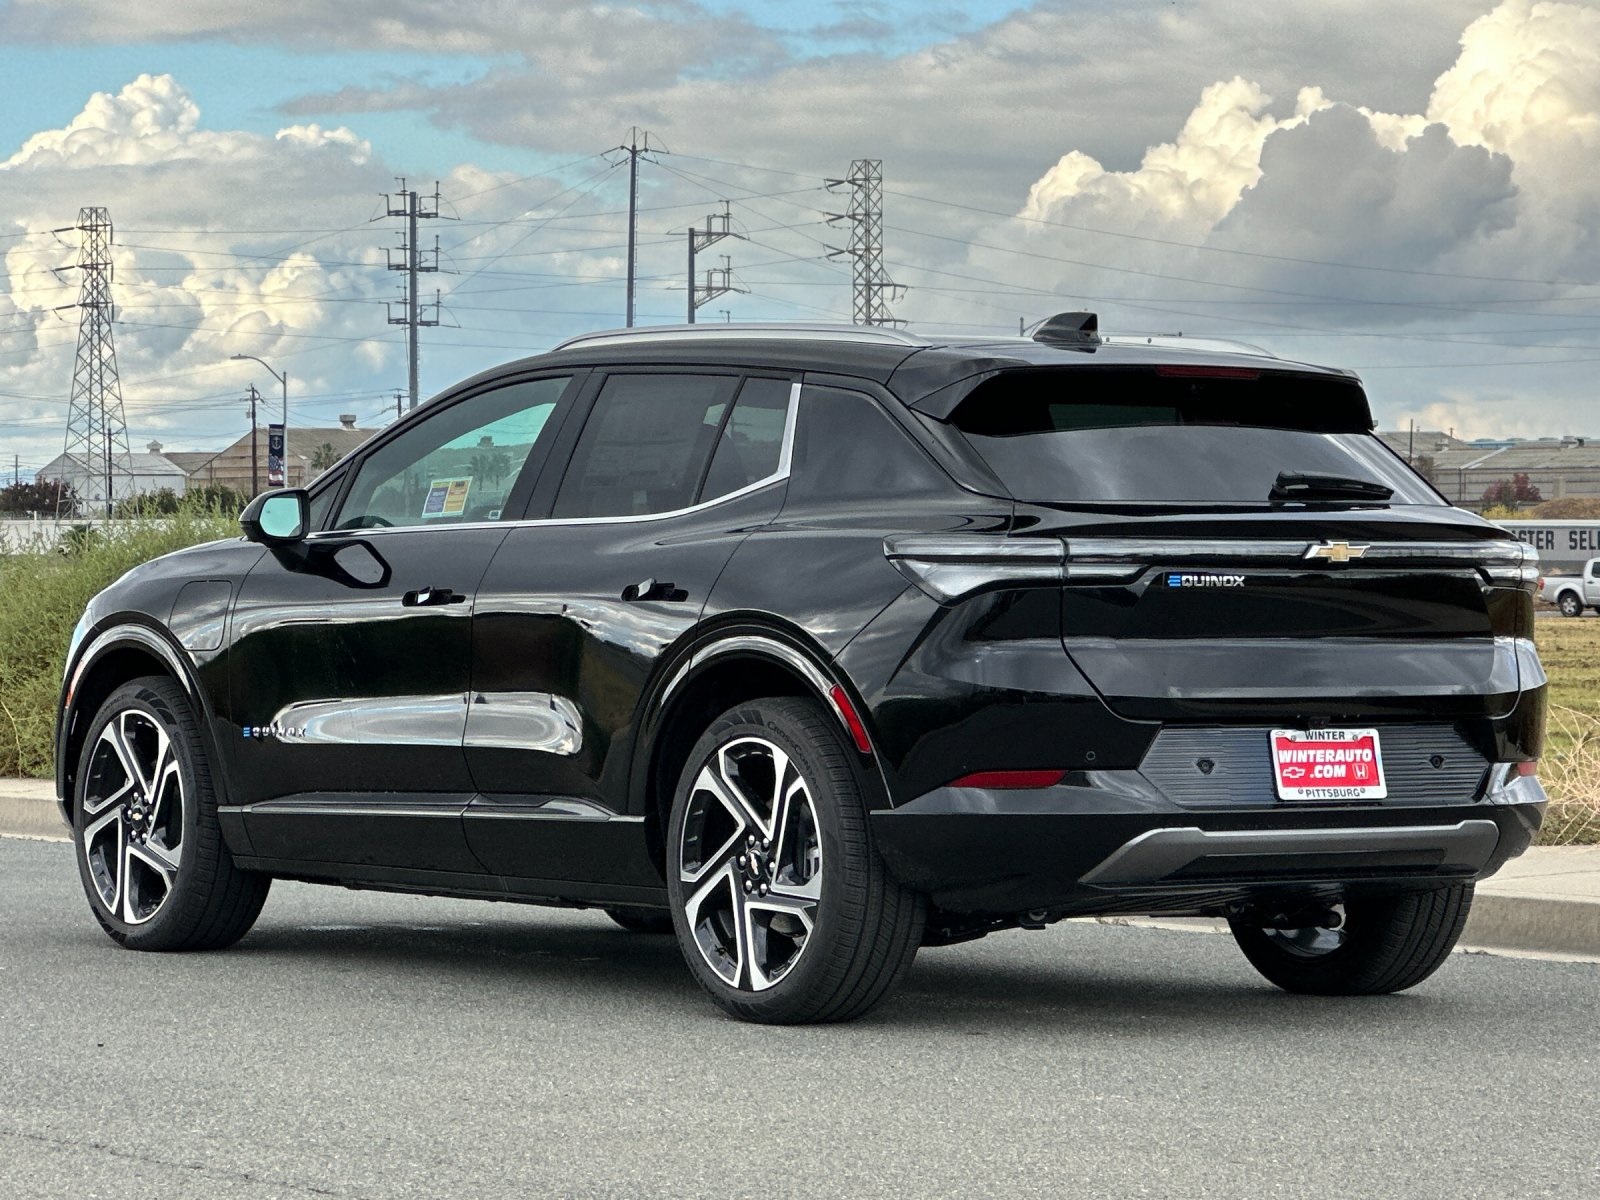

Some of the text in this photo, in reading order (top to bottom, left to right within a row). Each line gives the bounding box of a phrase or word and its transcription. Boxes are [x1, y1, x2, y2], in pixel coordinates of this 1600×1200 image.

[1512, 530, 1554, 550] STER
[1168, 575, 1245, 587] EQUINOX
[243, 726, 306, 738] EQUINOX
[1305, 731, 1346, 741] WINTER
[1278, 748, 1373, 763] WINTERAUTO
[1309, 764, 1347, 779] .COM
[1305, 788, 1361, 798] PITTSBURG
